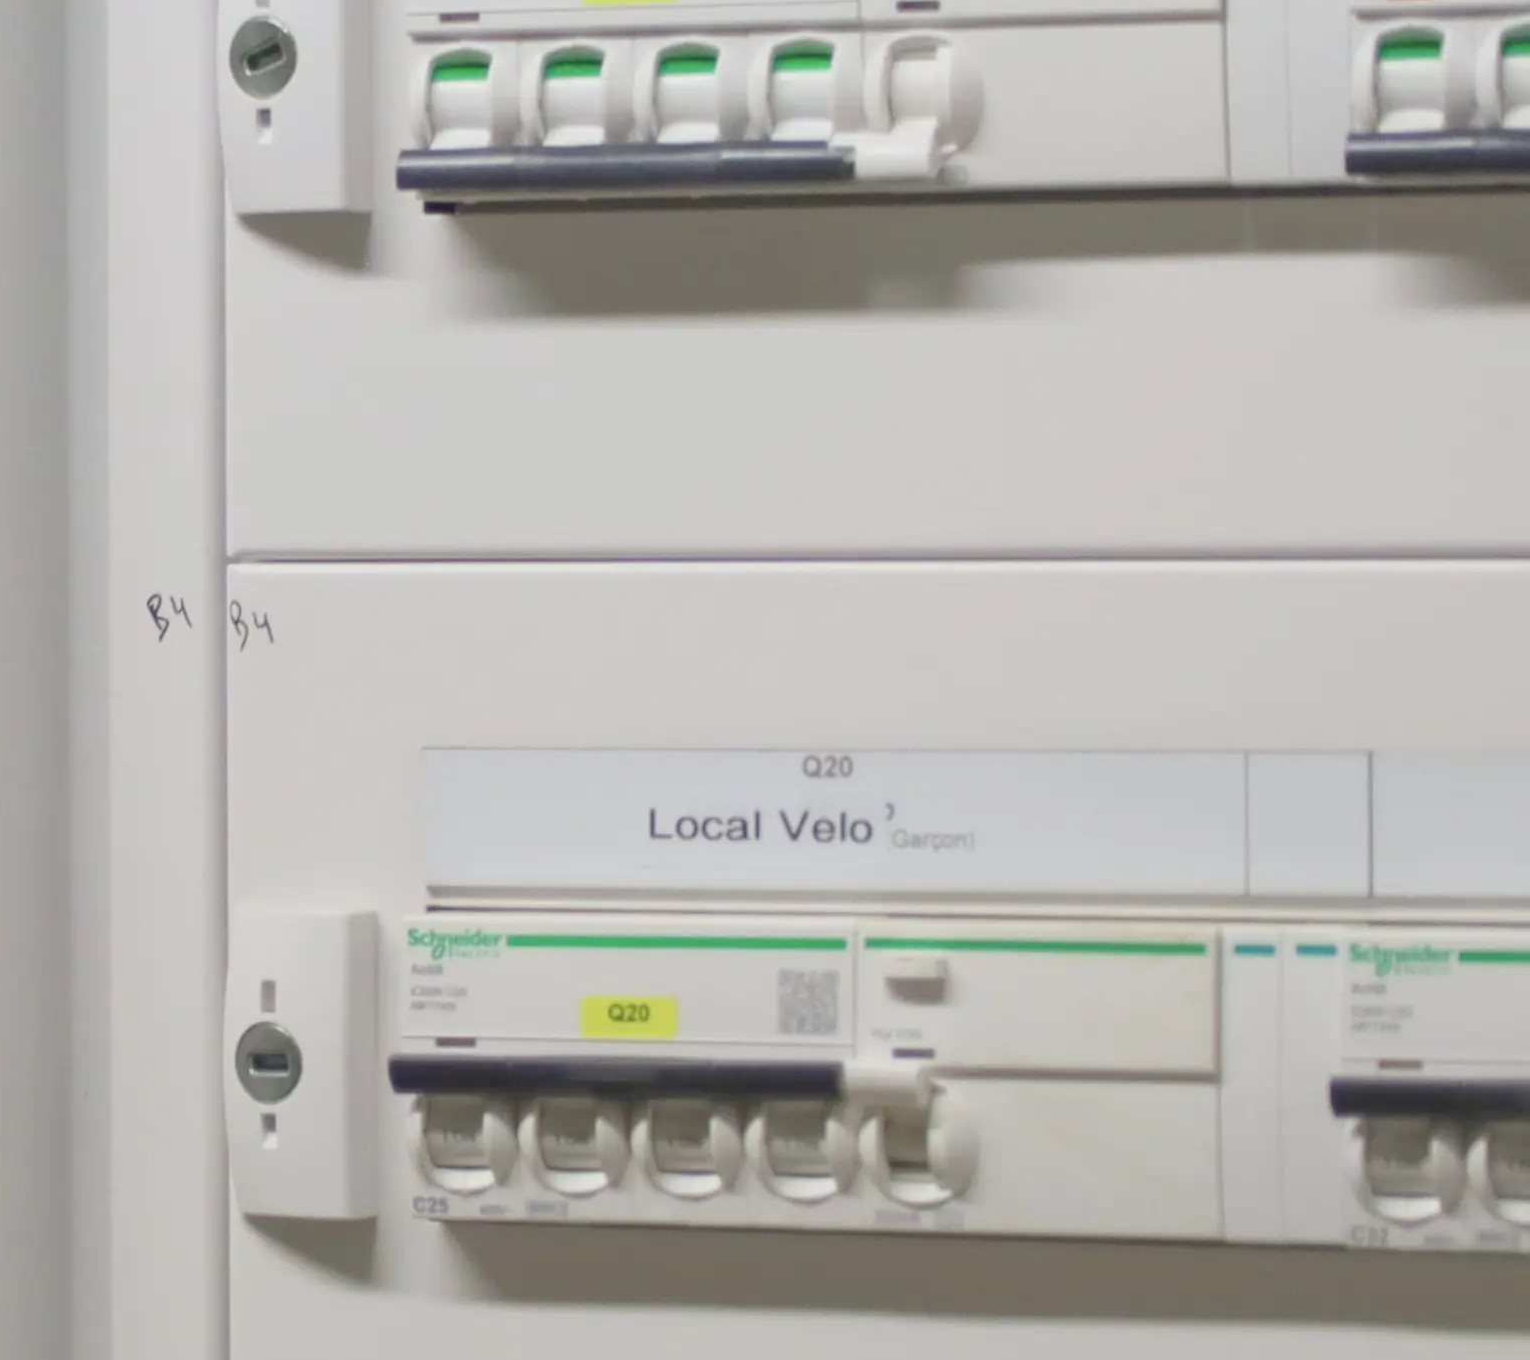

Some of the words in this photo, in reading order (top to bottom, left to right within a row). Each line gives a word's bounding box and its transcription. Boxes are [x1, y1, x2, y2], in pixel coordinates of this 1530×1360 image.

[146, 593, 192, 642] B4
[230, 599, 274, 652] B4
[798, 752, 857, 783] Q20
[649, 808, 761, 842] Local
[779, 810, 874, 844] Velo
[408, 928, 503, 960] Schneider
[604, 999, 655, 1026] Q20
